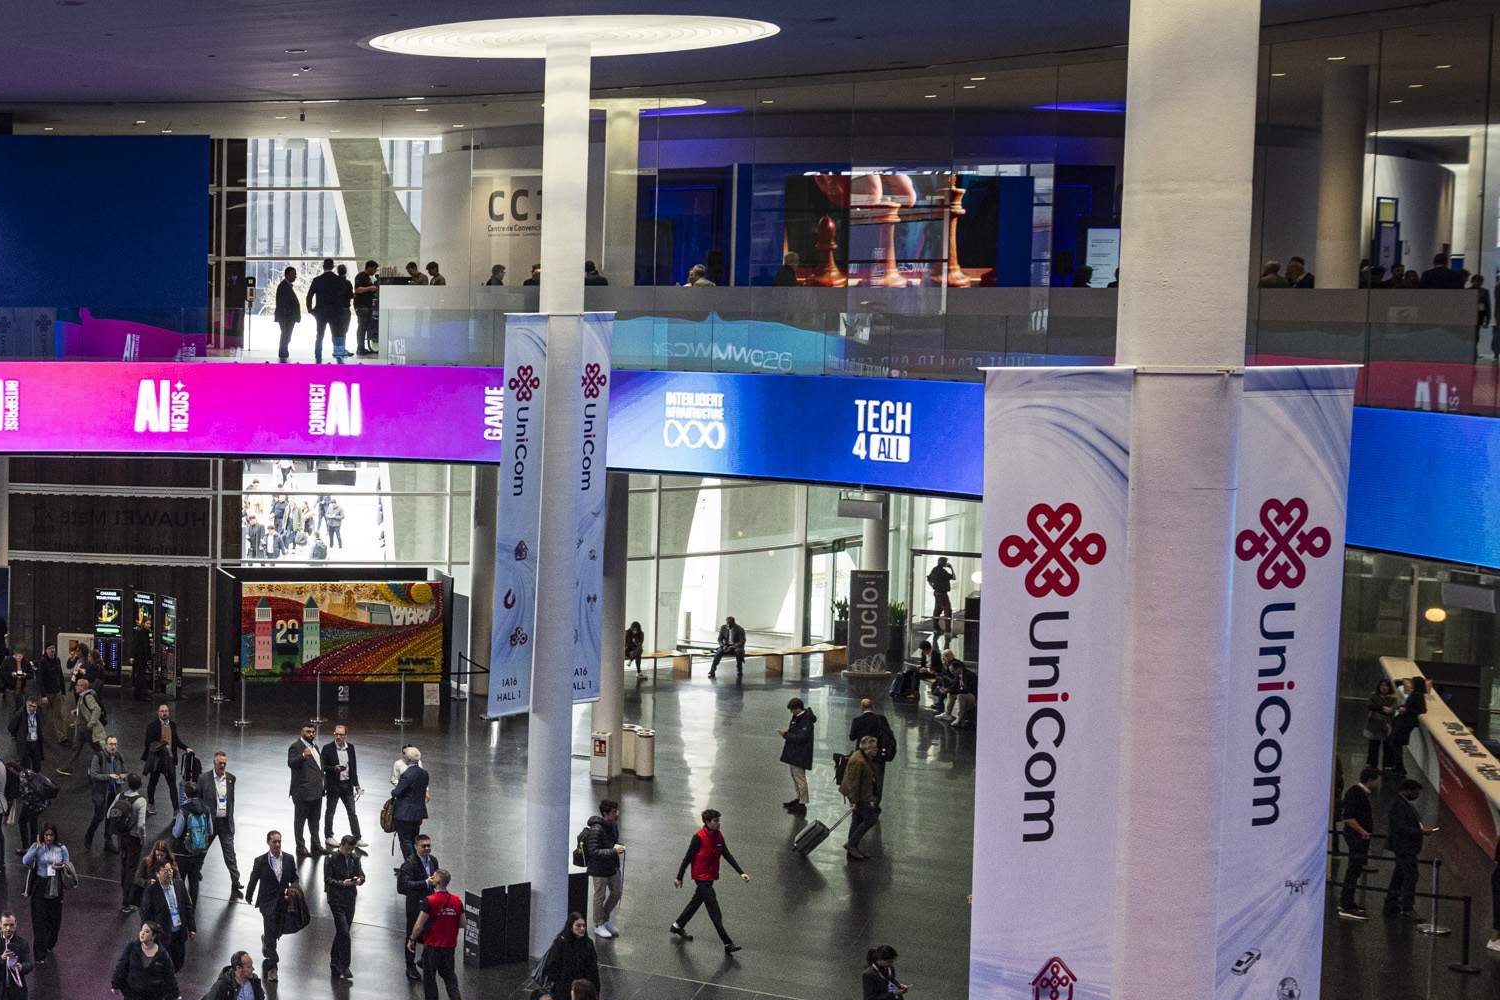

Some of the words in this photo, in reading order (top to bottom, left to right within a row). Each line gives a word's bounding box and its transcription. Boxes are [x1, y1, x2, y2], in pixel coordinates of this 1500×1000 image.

[134, 379, 171, 432] AI
[171, 391, 190, 432] NEXUS
[308, 383, 326, 436] CONNECT
[325, 381, 362, 436] AI
[483, 386, 505, 441] GAME
[854, 399, 912, 435] TECH
[852, 432, 867, 460] 4
[877, 437, 903, 460] ALL
[497, 692, 516, 702] HALL
[502, 678, 518, 687] 1A16
